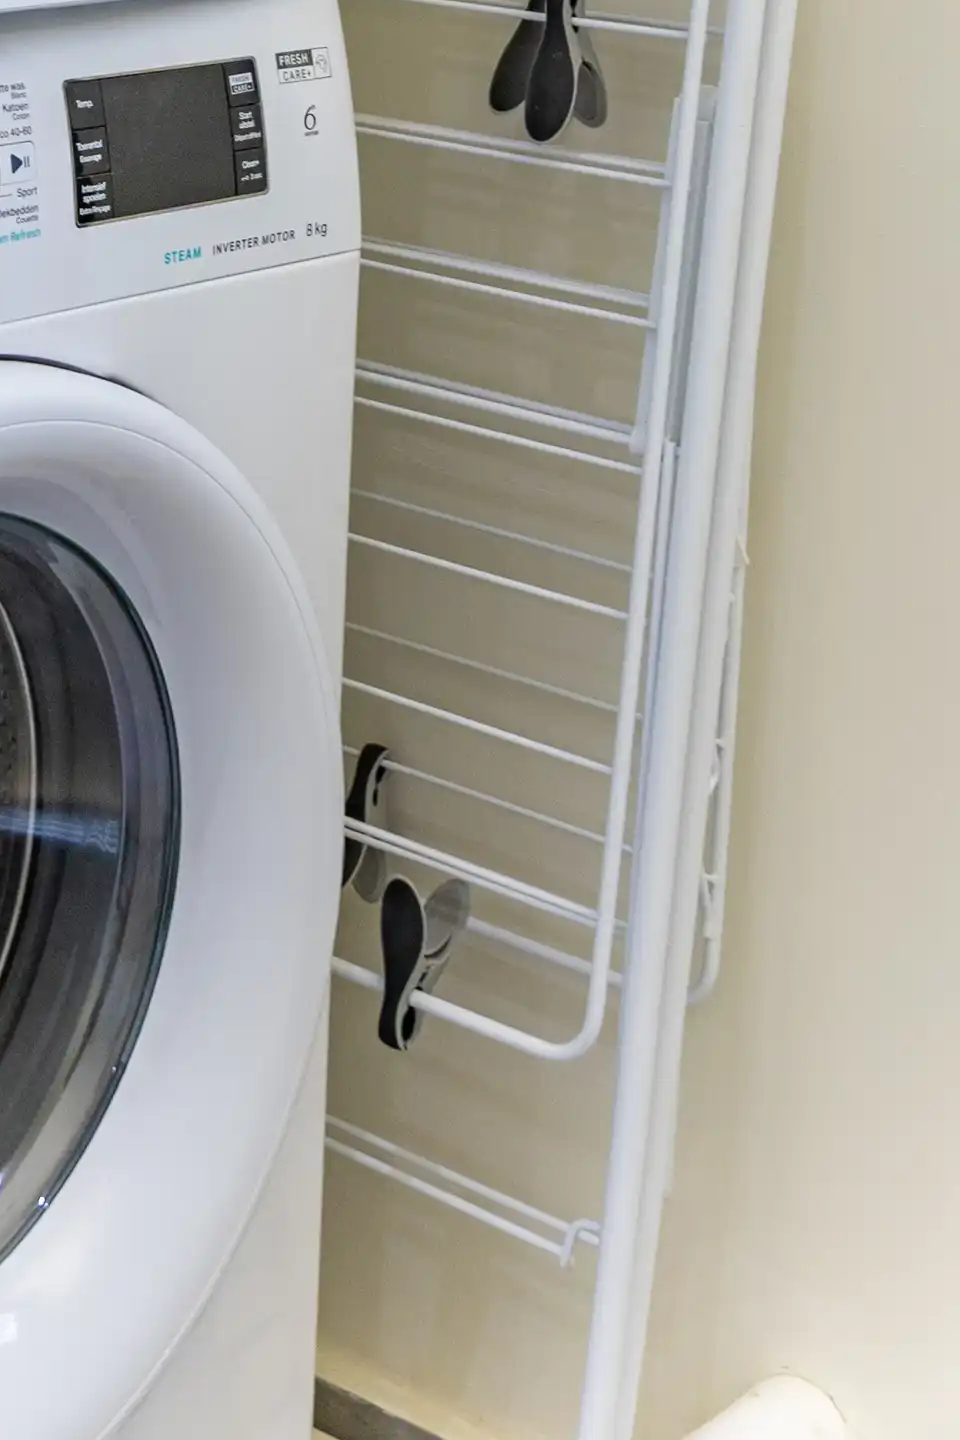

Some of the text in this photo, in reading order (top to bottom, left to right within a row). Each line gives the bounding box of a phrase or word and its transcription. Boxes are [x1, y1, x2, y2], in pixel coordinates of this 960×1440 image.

[278, 52, 308, 66] FRESH
[282, 68, 312, 81] CARE+
[2, 103, 29, 113] Katoen
[304, 104, 317, 131] 6
[10, 126, 32, 136] 40-60
[16, 187, 38, 199] Sport
[10, 228, 41, 242] Refresh
[306, 222, 328, 237] 8 kg
[163, 229, 296, 265] STEAM INVERTER MOTOR
